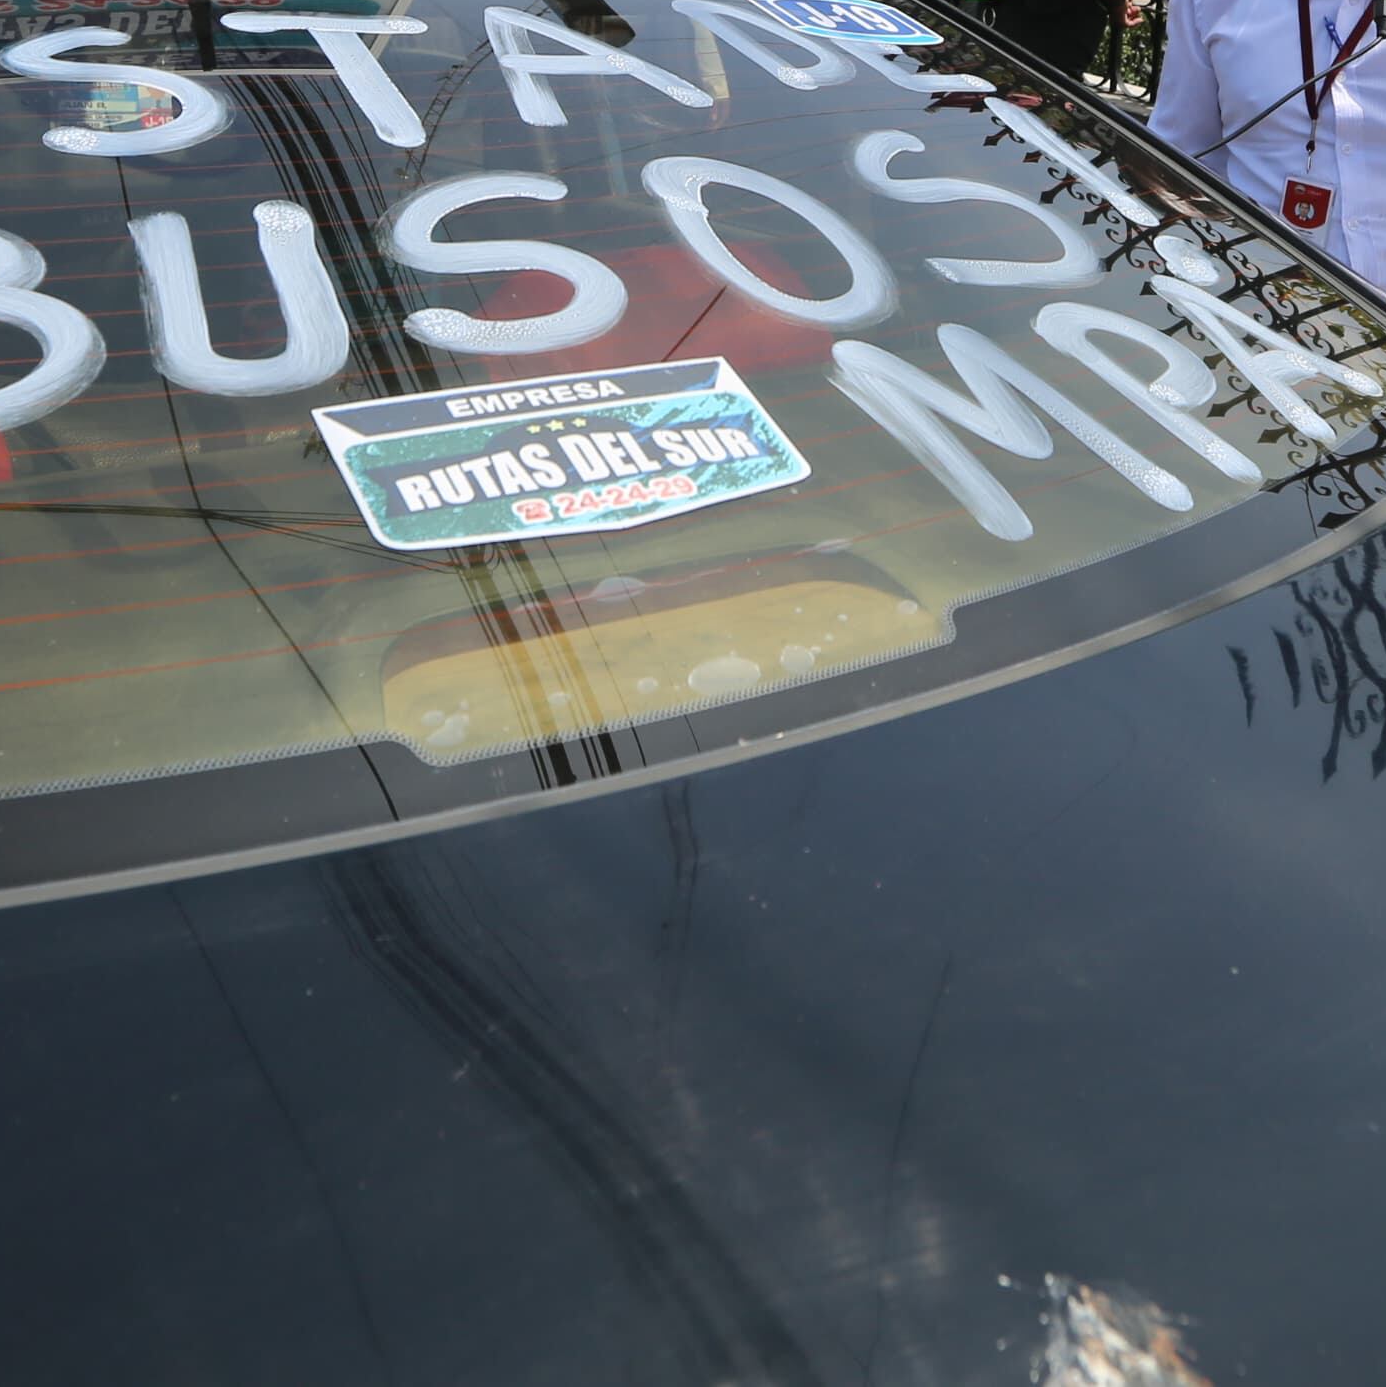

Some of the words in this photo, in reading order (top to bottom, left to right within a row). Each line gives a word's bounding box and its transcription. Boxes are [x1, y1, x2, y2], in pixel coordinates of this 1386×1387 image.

[796, 1, 900, 33] J-19
[445, 379, 626, 418] EMPRESA
[824, 273, 1384, 543] MPA
[396, 448, 568, 513] RUTAS
[557, 430, 665, 485] DEL
[656, 425, 761, 467] SUR
[558, 475, 696, 516] 24-24-29
